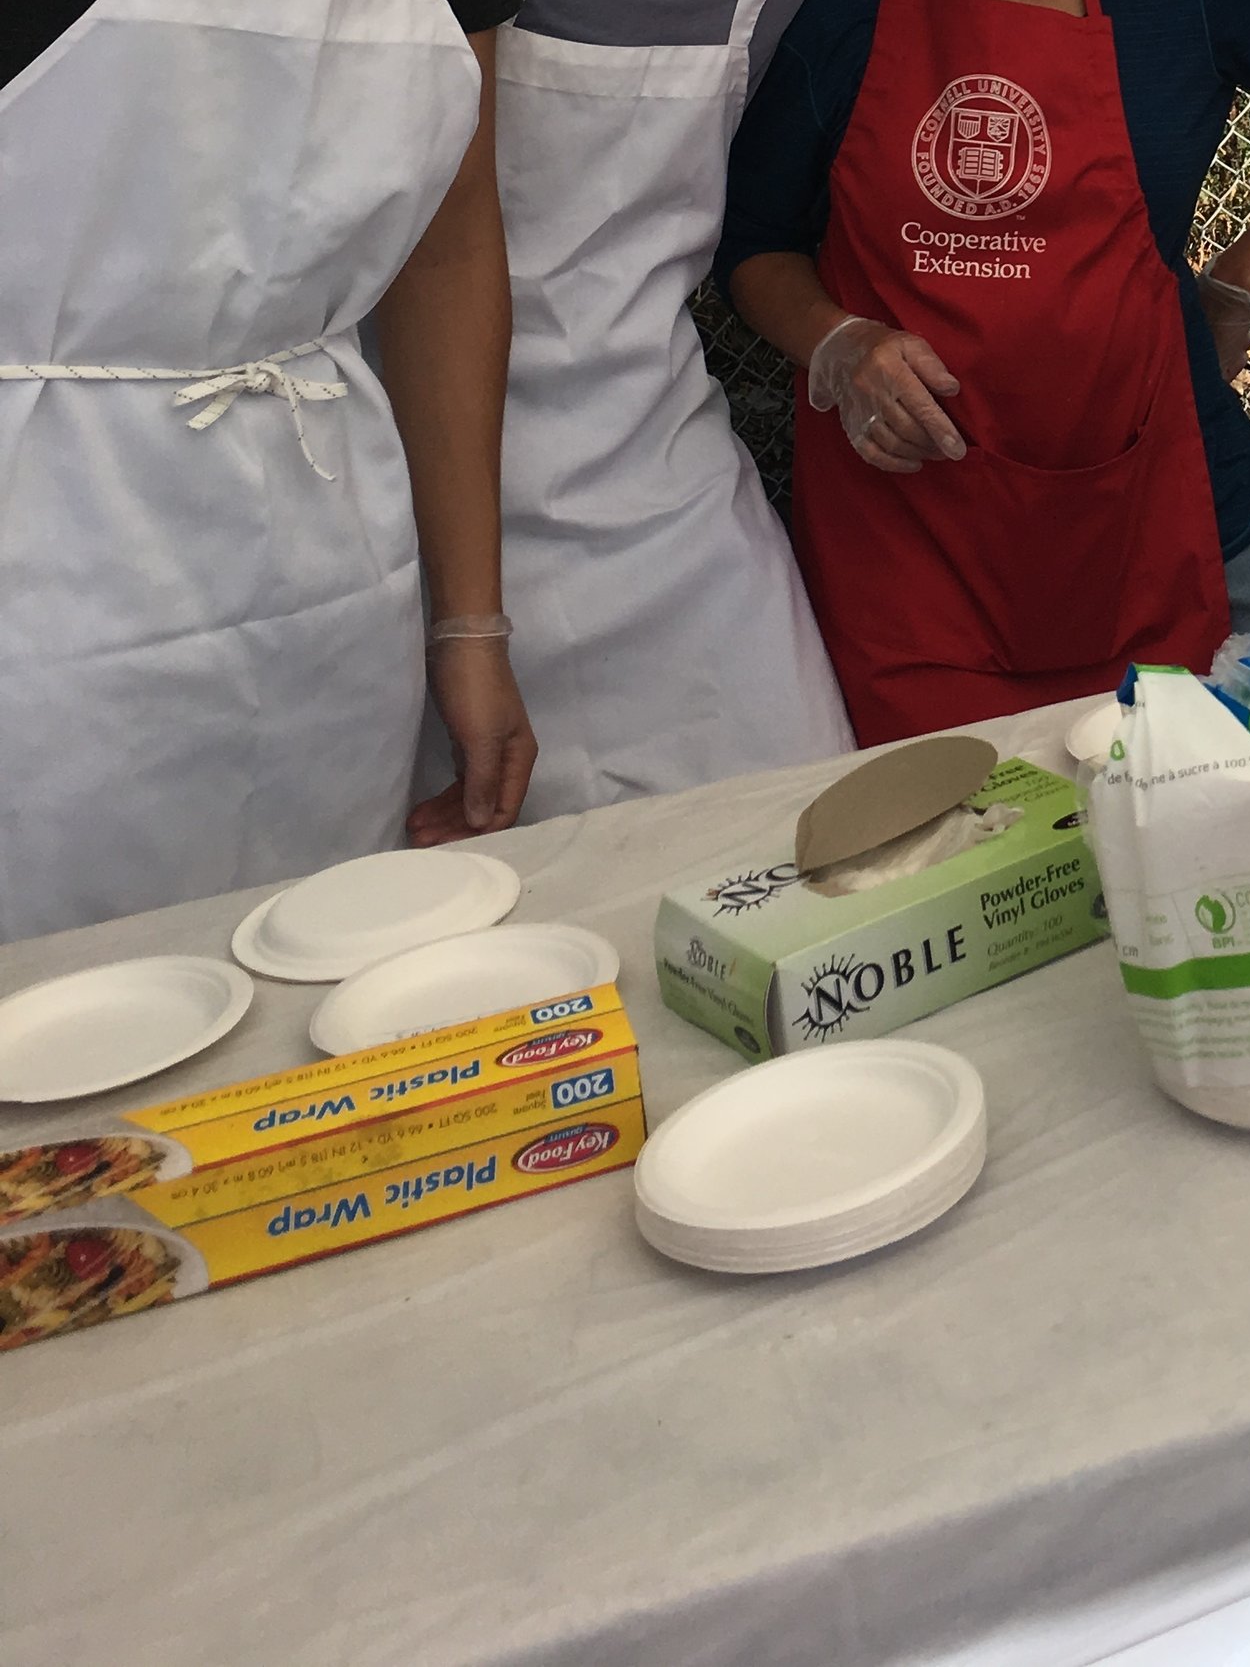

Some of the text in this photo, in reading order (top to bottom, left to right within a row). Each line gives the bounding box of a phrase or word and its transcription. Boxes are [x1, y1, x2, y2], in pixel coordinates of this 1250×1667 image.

[920, 79, 1047, 156] CORNELL UNIVERSITY
[916, 151, 978, 216] FOUNDED
[1018, 163, 1045, 201] 1865
[901, 222, 1047, 254] Cooperative
[913, 250, 1031, 280] Extension
[1178, 763, 1210, 779] sucre
[980, 858, 1081, 911] Powder-Free
[983, 877, 1085, 931] Vinyl Gloves
[687, 936, 727, 982] NOBLE
[1212, 936, 1235, 950] BPI
[803, 924, 968, 1034] NOBLE
[536, 998, 588, 1022] 200
[511, 1032, 594, 1064] Key Food
[253, 1059, 481, 1132] Plastic Wrap
[556, 1072, 609, 1105] 200
[527, 1131, 610, 1168] Key Food
[267, 1155, 497, 1237] Plastic Wrap
